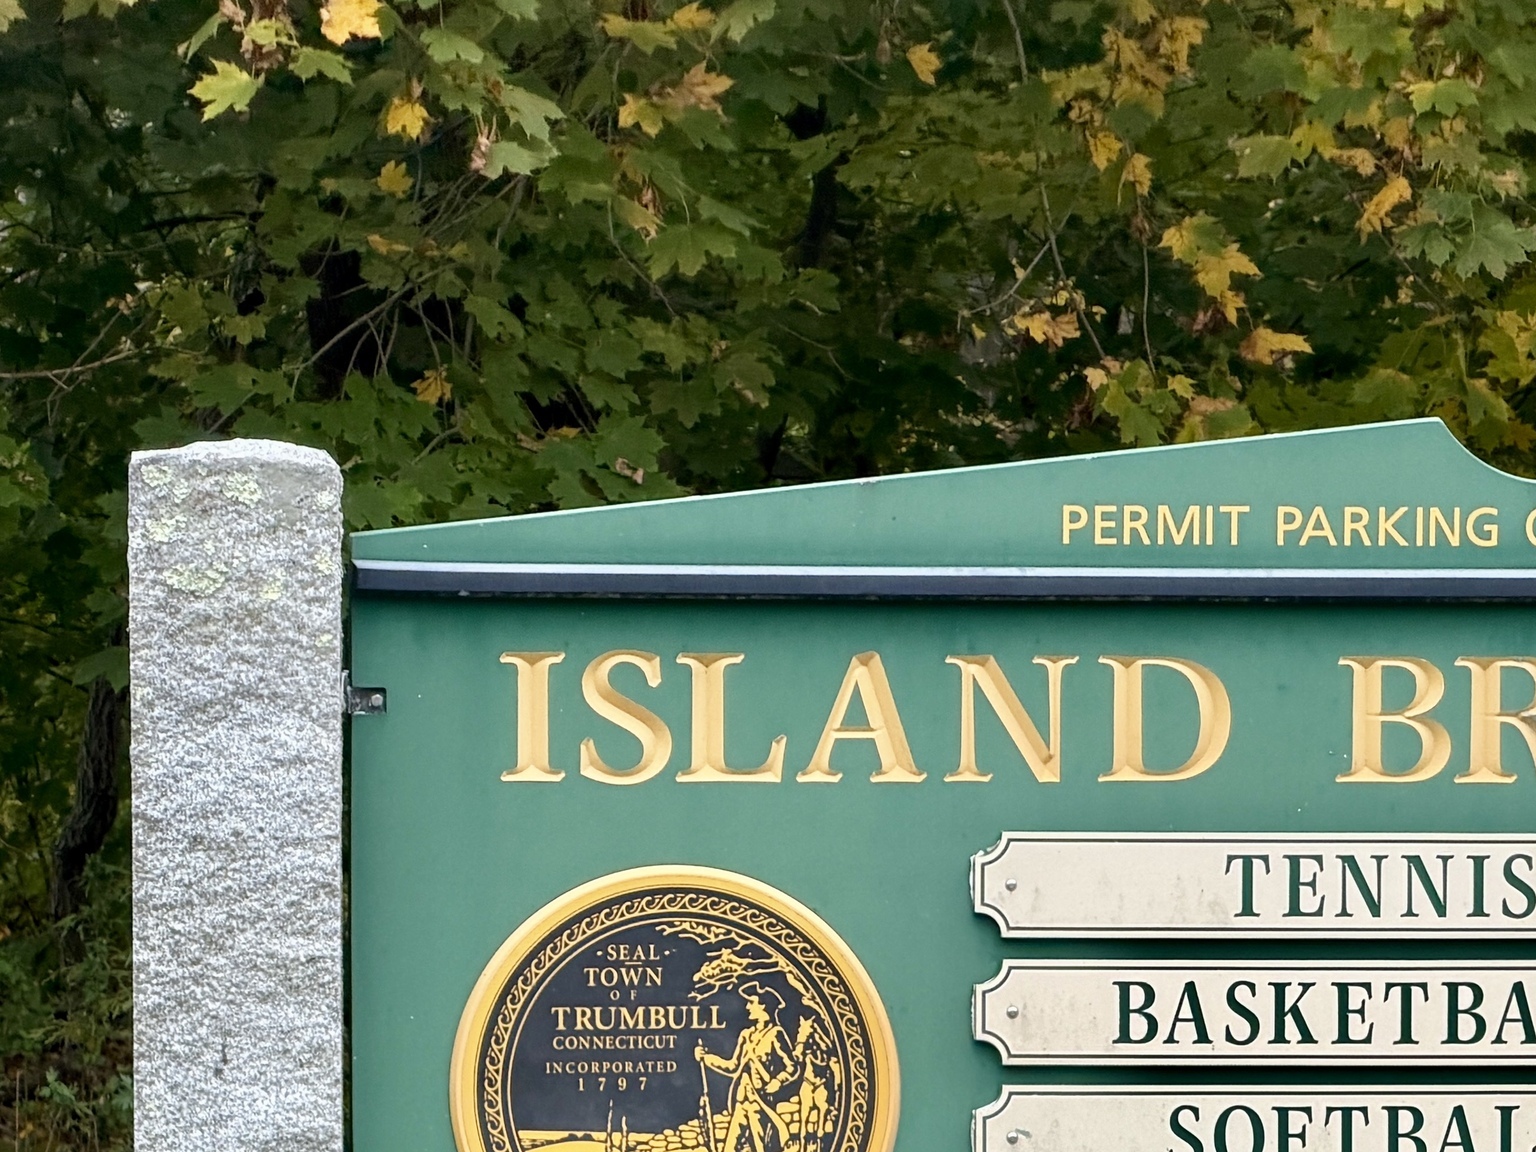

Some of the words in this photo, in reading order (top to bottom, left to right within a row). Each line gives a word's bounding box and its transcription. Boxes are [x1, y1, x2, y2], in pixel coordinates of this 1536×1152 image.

[1060, 504, 1250, 546] PERMIT
[1276, 506, 1500, 547] PARKING
[500, 650, 1233, 786] ISLAND
[583, 966, 664, 987] TOWN
[609, 988, 639, 1001] OF
[550, 1004, 727, 1031] TRUMBULL
[551, 1034, 678, 1051] CONNECTICUT
[545, 1060, 678, 1075] INCORPORATED
[577, 1076, 648, 1092] 1797
